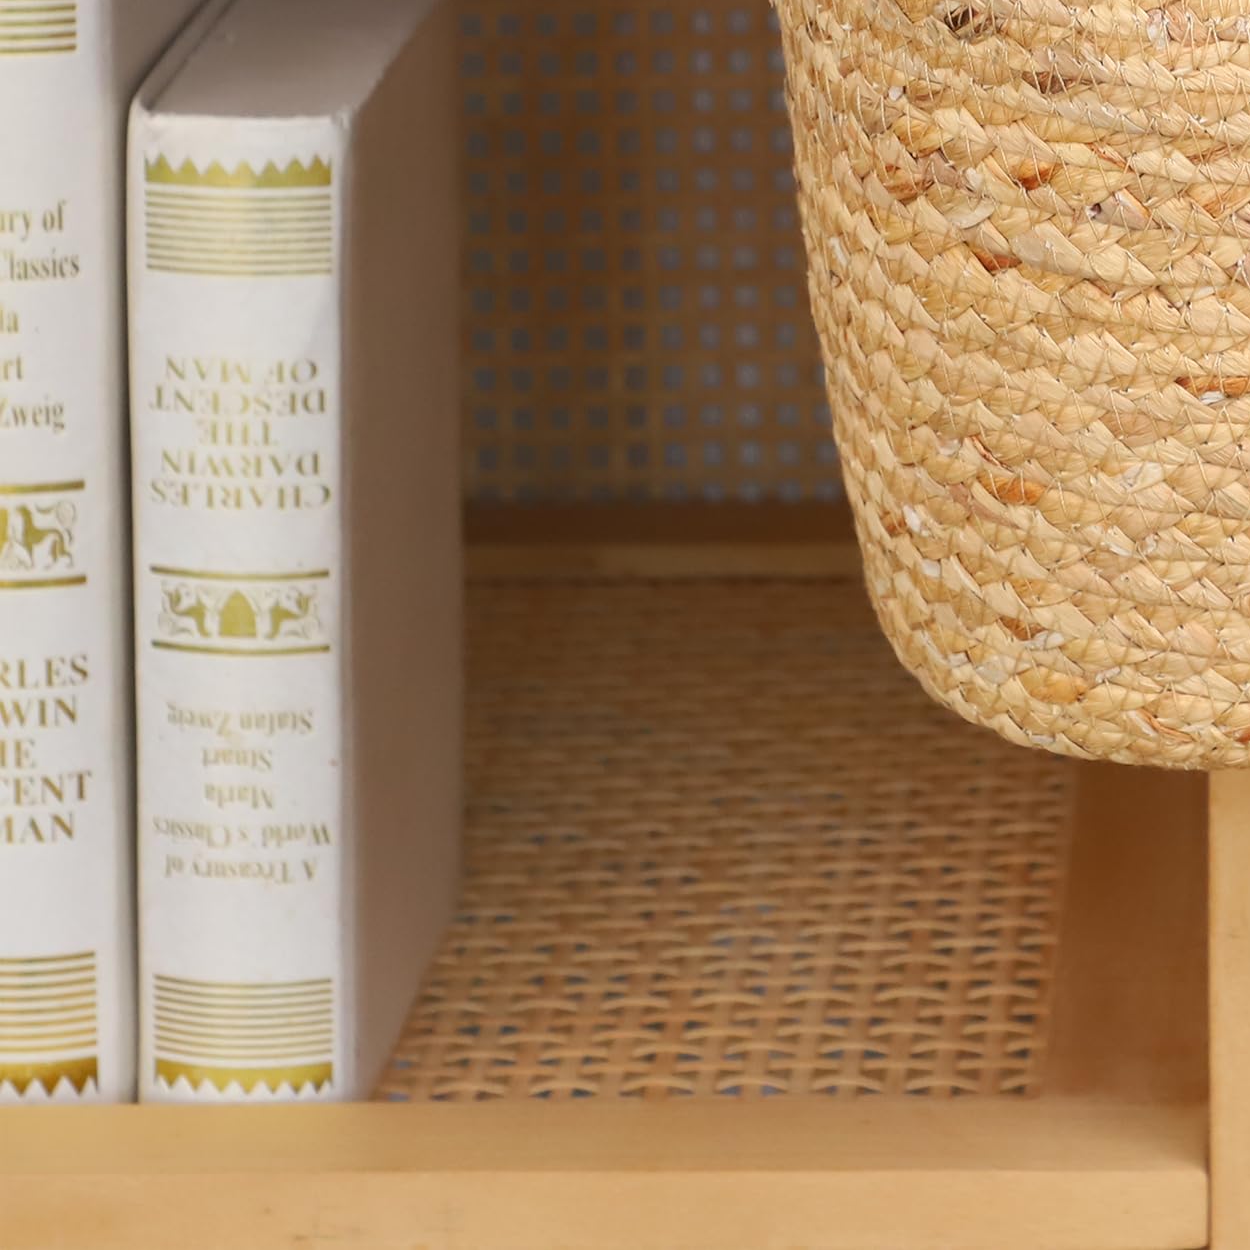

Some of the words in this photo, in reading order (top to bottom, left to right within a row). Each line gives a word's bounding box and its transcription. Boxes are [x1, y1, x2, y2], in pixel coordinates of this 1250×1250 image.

[42, 199, 67, 234] of
[166, 355, 252, 383] MAN
[265, 357, 318, 384] OF
[149, 385, 326, 416] DESCENT
[194, 419, 279, 446] THE
[162, 449, 320, 478] DARWIN
[151, 480, 331, 510] CHARLES
[0, 770, 92, 806] ENT
[302, 858, 318, 881] A
